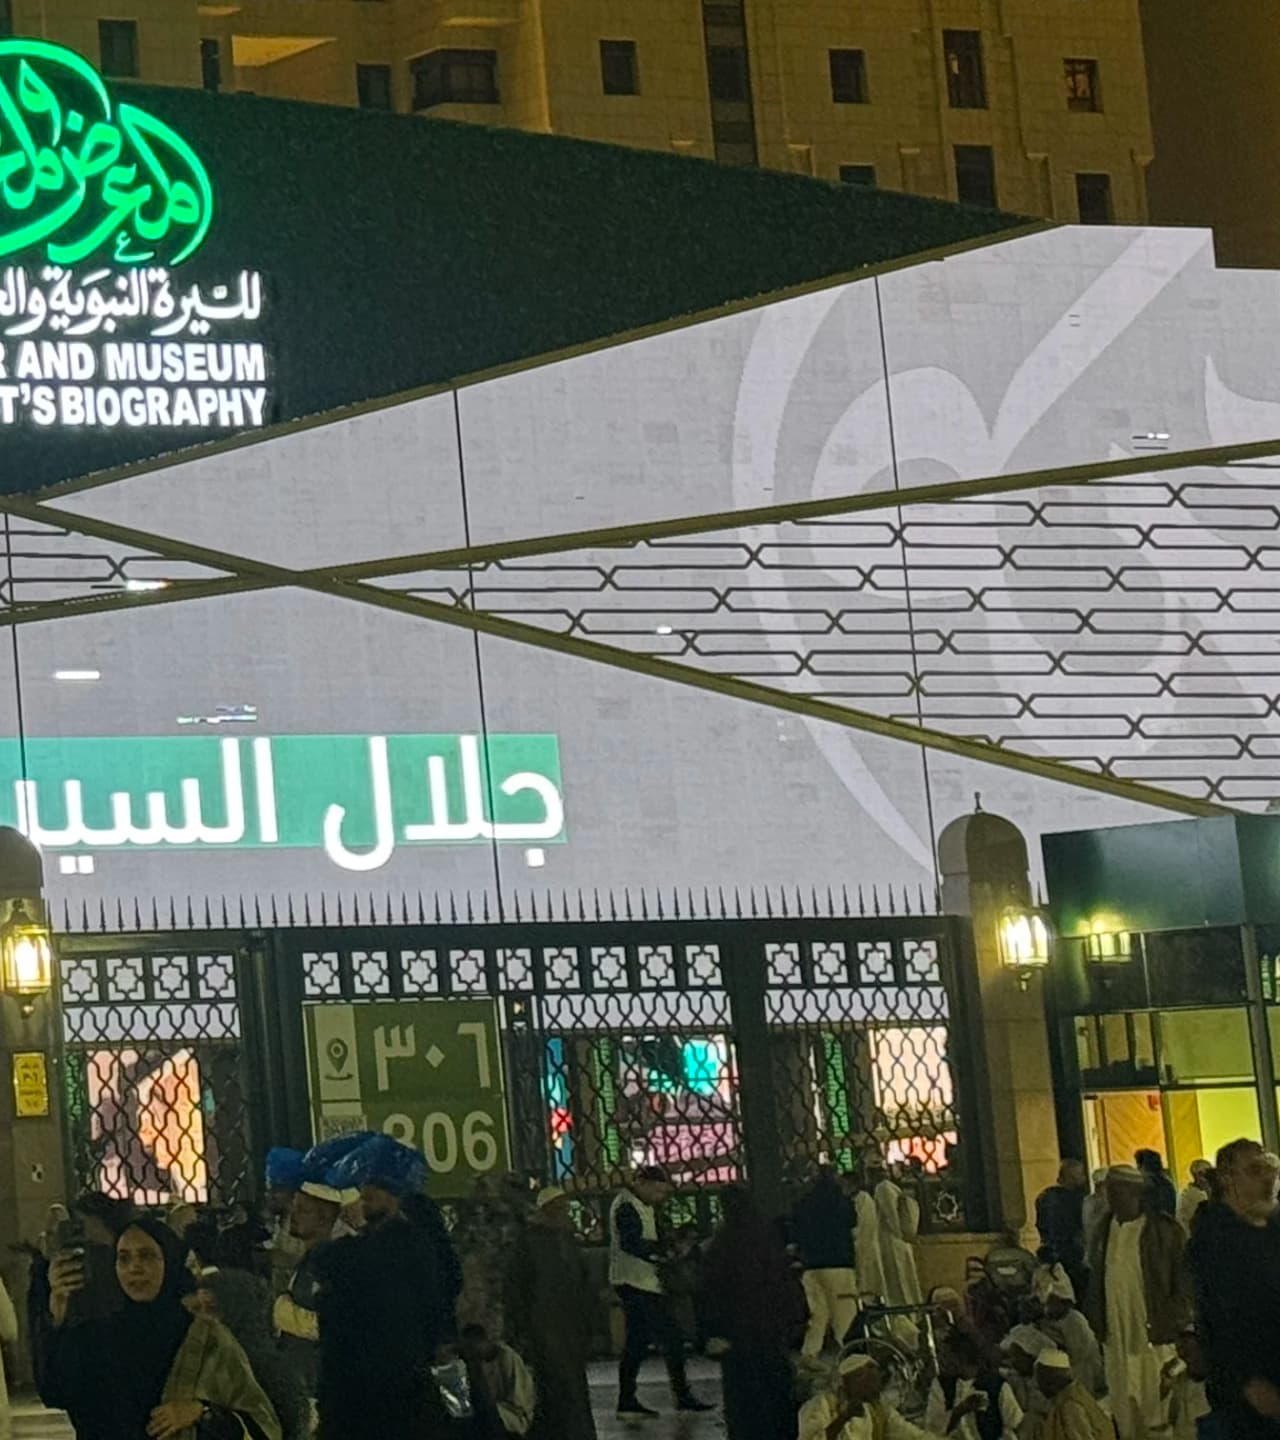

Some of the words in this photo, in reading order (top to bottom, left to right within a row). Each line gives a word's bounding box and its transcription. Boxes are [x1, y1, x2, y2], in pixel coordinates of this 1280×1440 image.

[17, 340, 96, 381] AND
[104, 343, 266, 383] MUSEUM
[60, 386, 267, 428] BIOGRAPHY
[324, 734, 564, 871] جلال
[372, 1021, 491, 1092] ٣٠٦
